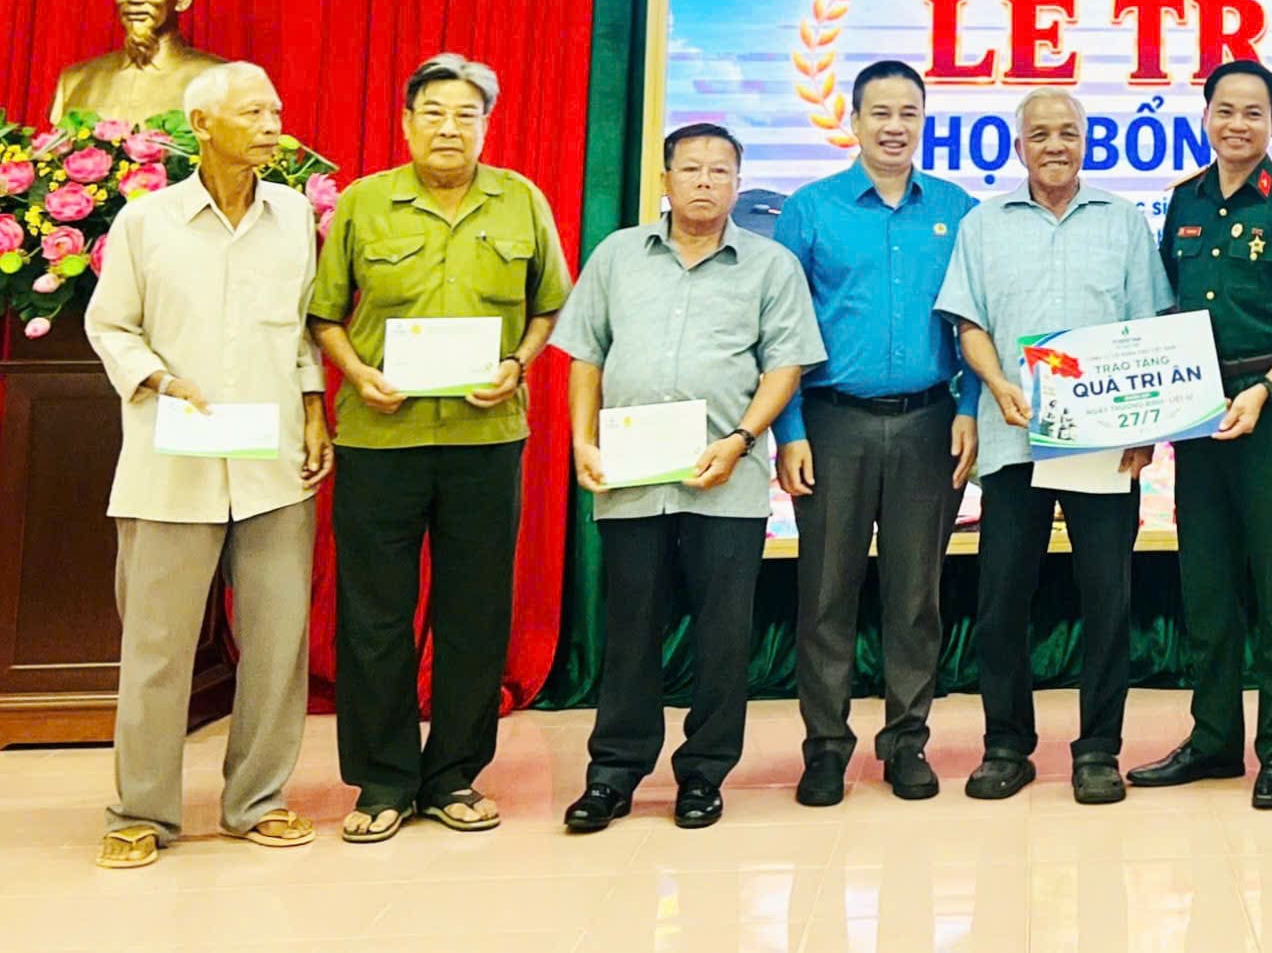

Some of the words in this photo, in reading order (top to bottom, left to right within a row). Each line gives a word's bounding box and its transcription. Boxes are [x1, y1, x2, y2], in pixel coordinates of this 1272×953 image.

[923, 114, 1012, 185] HỌ
[1082, 95, 1212, 172] BỔN
[1094, 361, 1131, 373] TRAO
[1072, 373, 1120, 398] QUÀ
[1125, 370, 1163, 391] TRI
[1171, 364, 1202, 384] ÂN
[1117, 408, 1161, 428] 27/7
